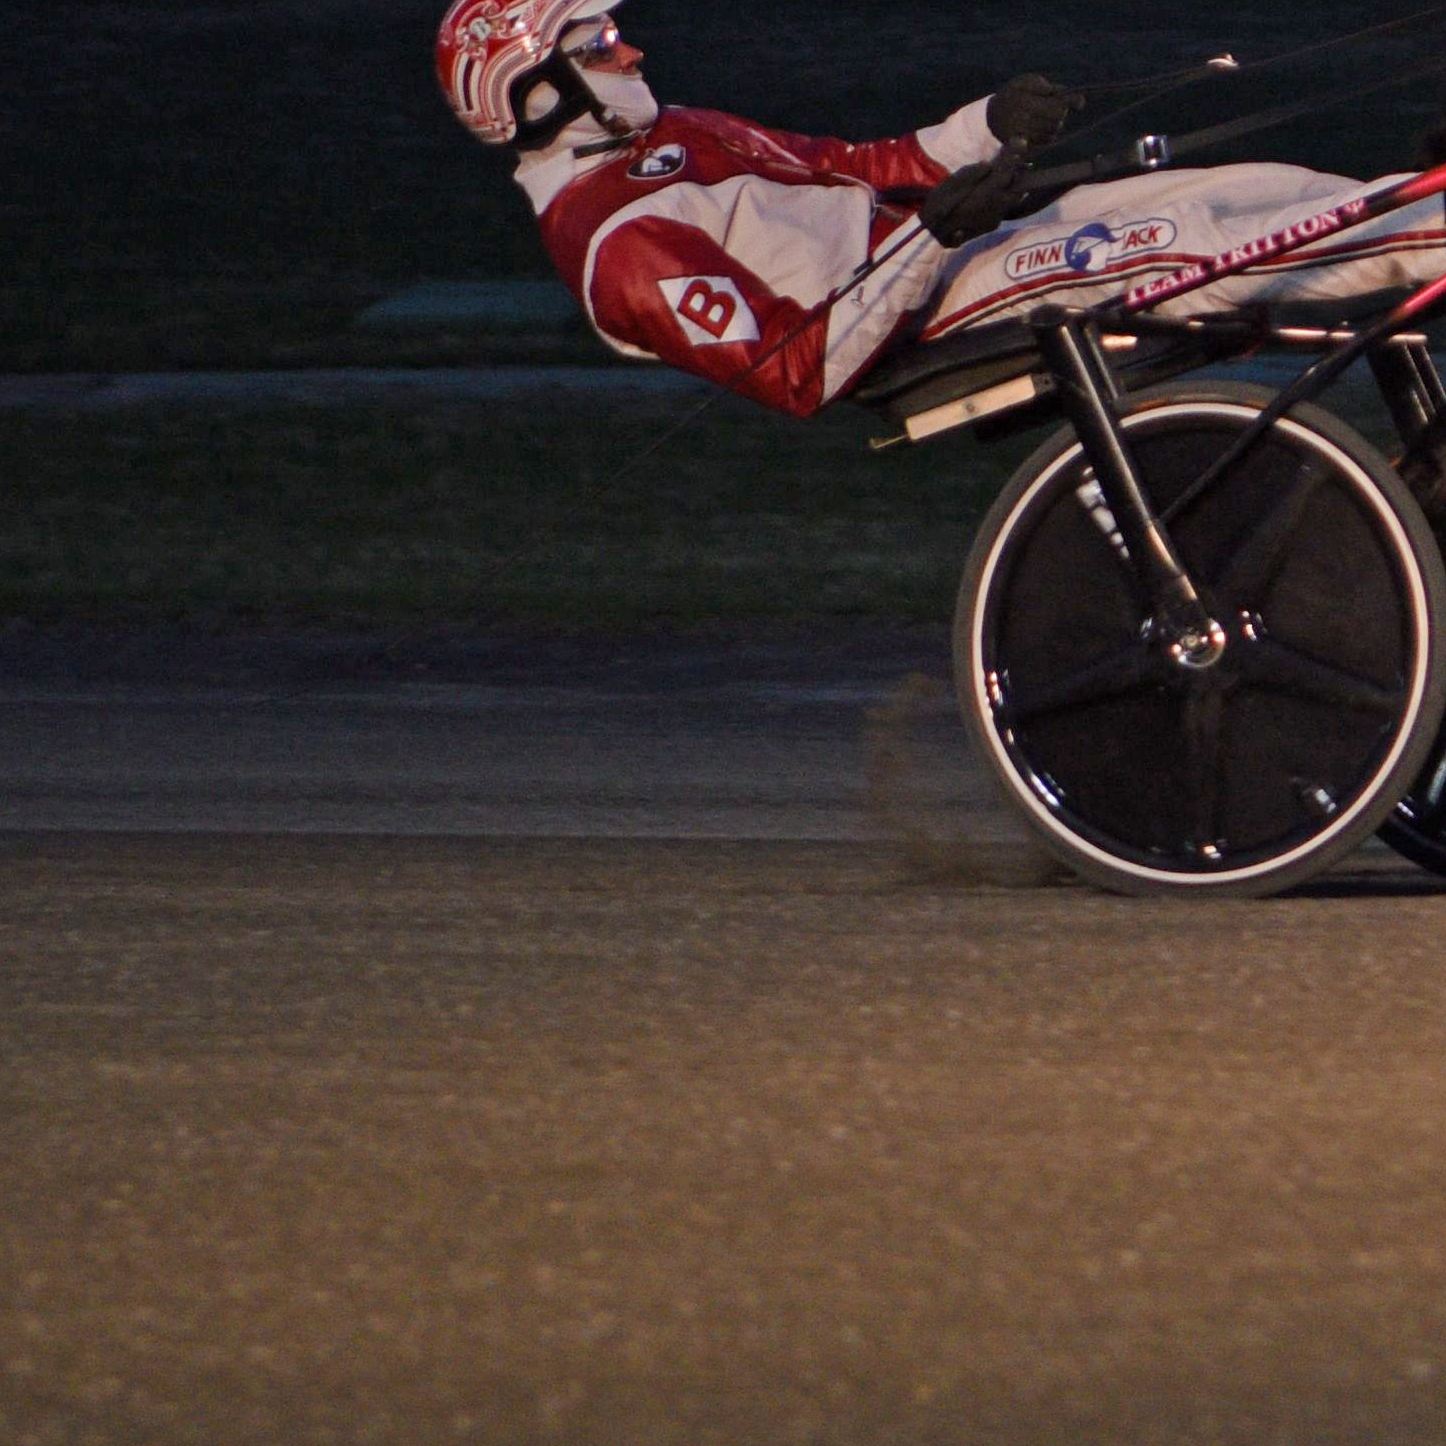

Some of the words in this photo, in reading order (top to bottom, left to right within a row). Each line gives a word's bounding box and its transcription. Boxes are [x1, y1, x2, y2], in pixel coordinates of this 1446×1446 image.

[1015, 244, 1063, 273] FINN
[1127, 260, 1205, 304] TEAM
[1211, 209, 1342, 271] TRITTON
[677, 279, 737, 340] B
